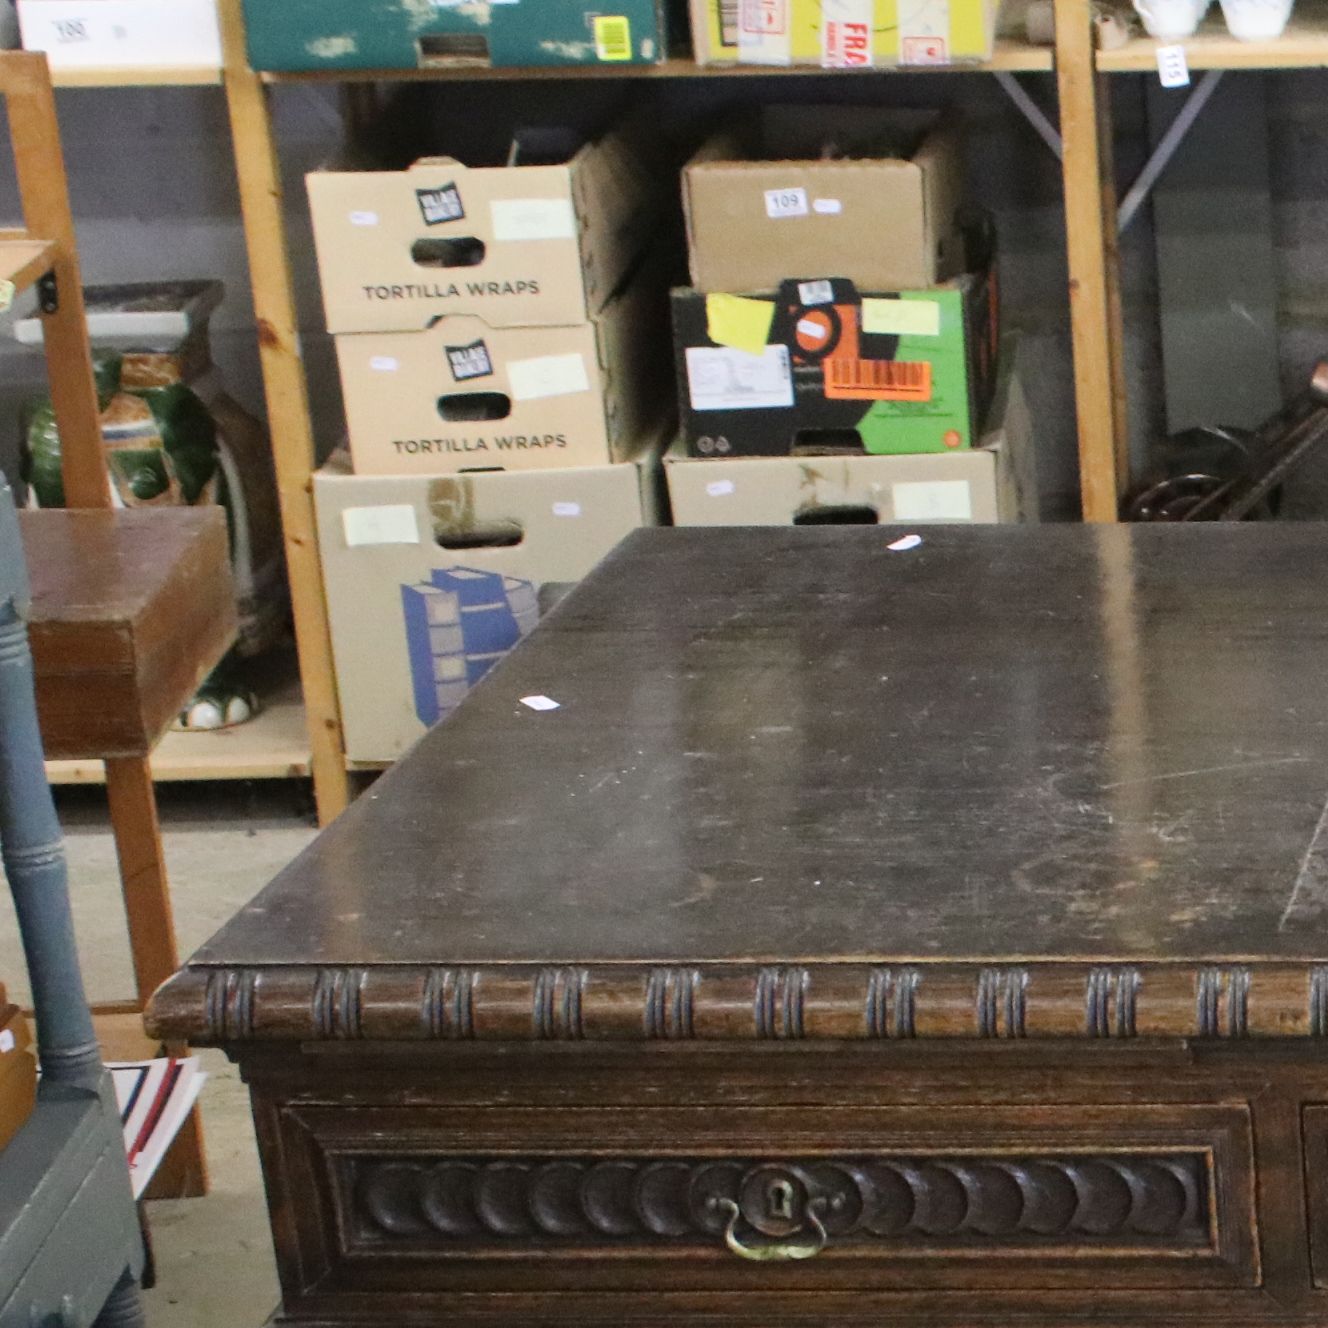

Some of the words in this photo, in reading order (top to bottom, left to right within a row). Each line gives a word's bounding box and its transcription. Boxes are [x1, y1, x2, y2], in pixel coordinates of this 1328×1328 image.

[773, 194, 799, 209] 109
[362, 281, 460, 300] TORTILLA
[466, 280, 541, 297] WRAPS
[392, 437, 489, 454] TORTILLA
[494, 434, 567, 449] WRAPS
